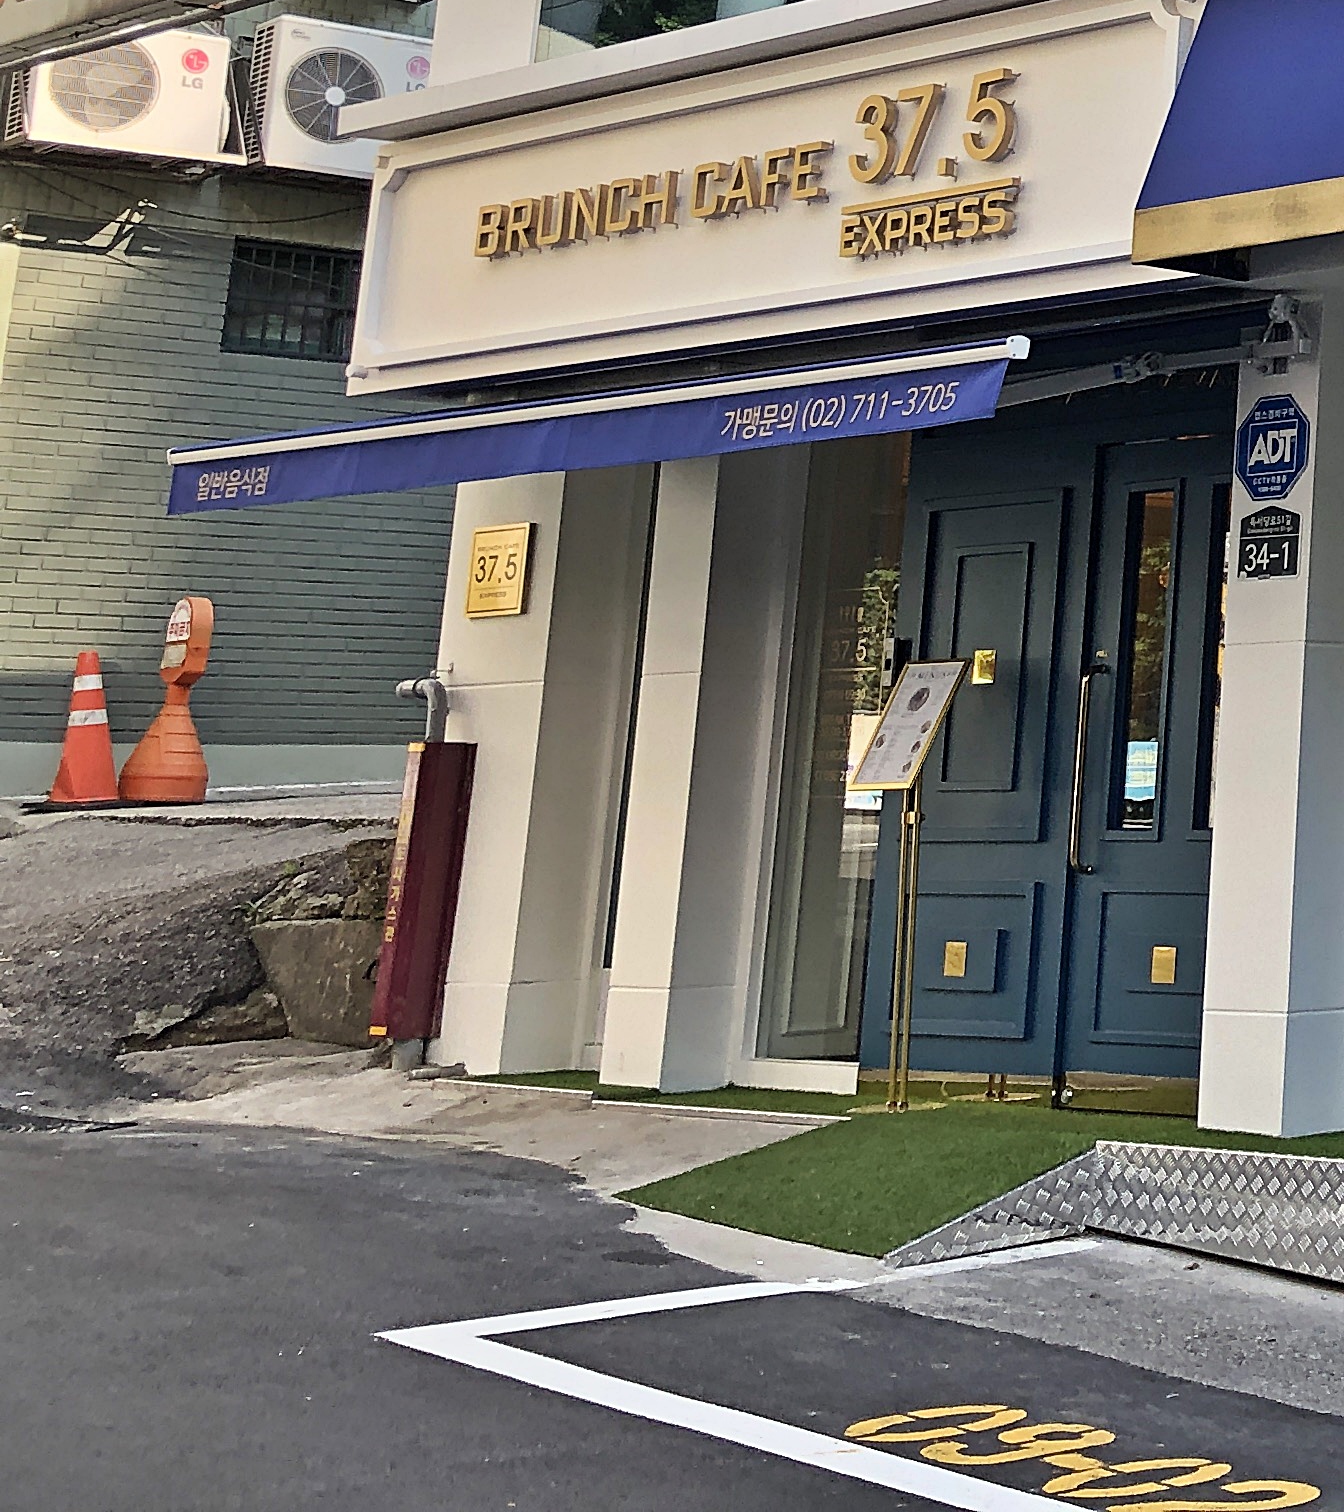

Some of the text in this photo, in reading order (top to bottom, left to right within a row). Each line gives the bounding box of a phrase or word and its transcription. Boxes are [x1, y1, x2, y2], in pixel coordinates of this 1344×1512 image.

[181, 75, 204, 90] LG
[473, 66, 1022, 261] BRUNCH CAFE 37.5
[838, 186, 1021, 261] EXPRESS
[719, 379, 959, 440] 가맹문의 (02) 711-3705
[1248, 427, 1298, 468] ADT
[196, 465, 270, 503] 일반음식점
[474, 552, 518, 584] 37.5
[1243, 540, 1290, 573] 34-1
